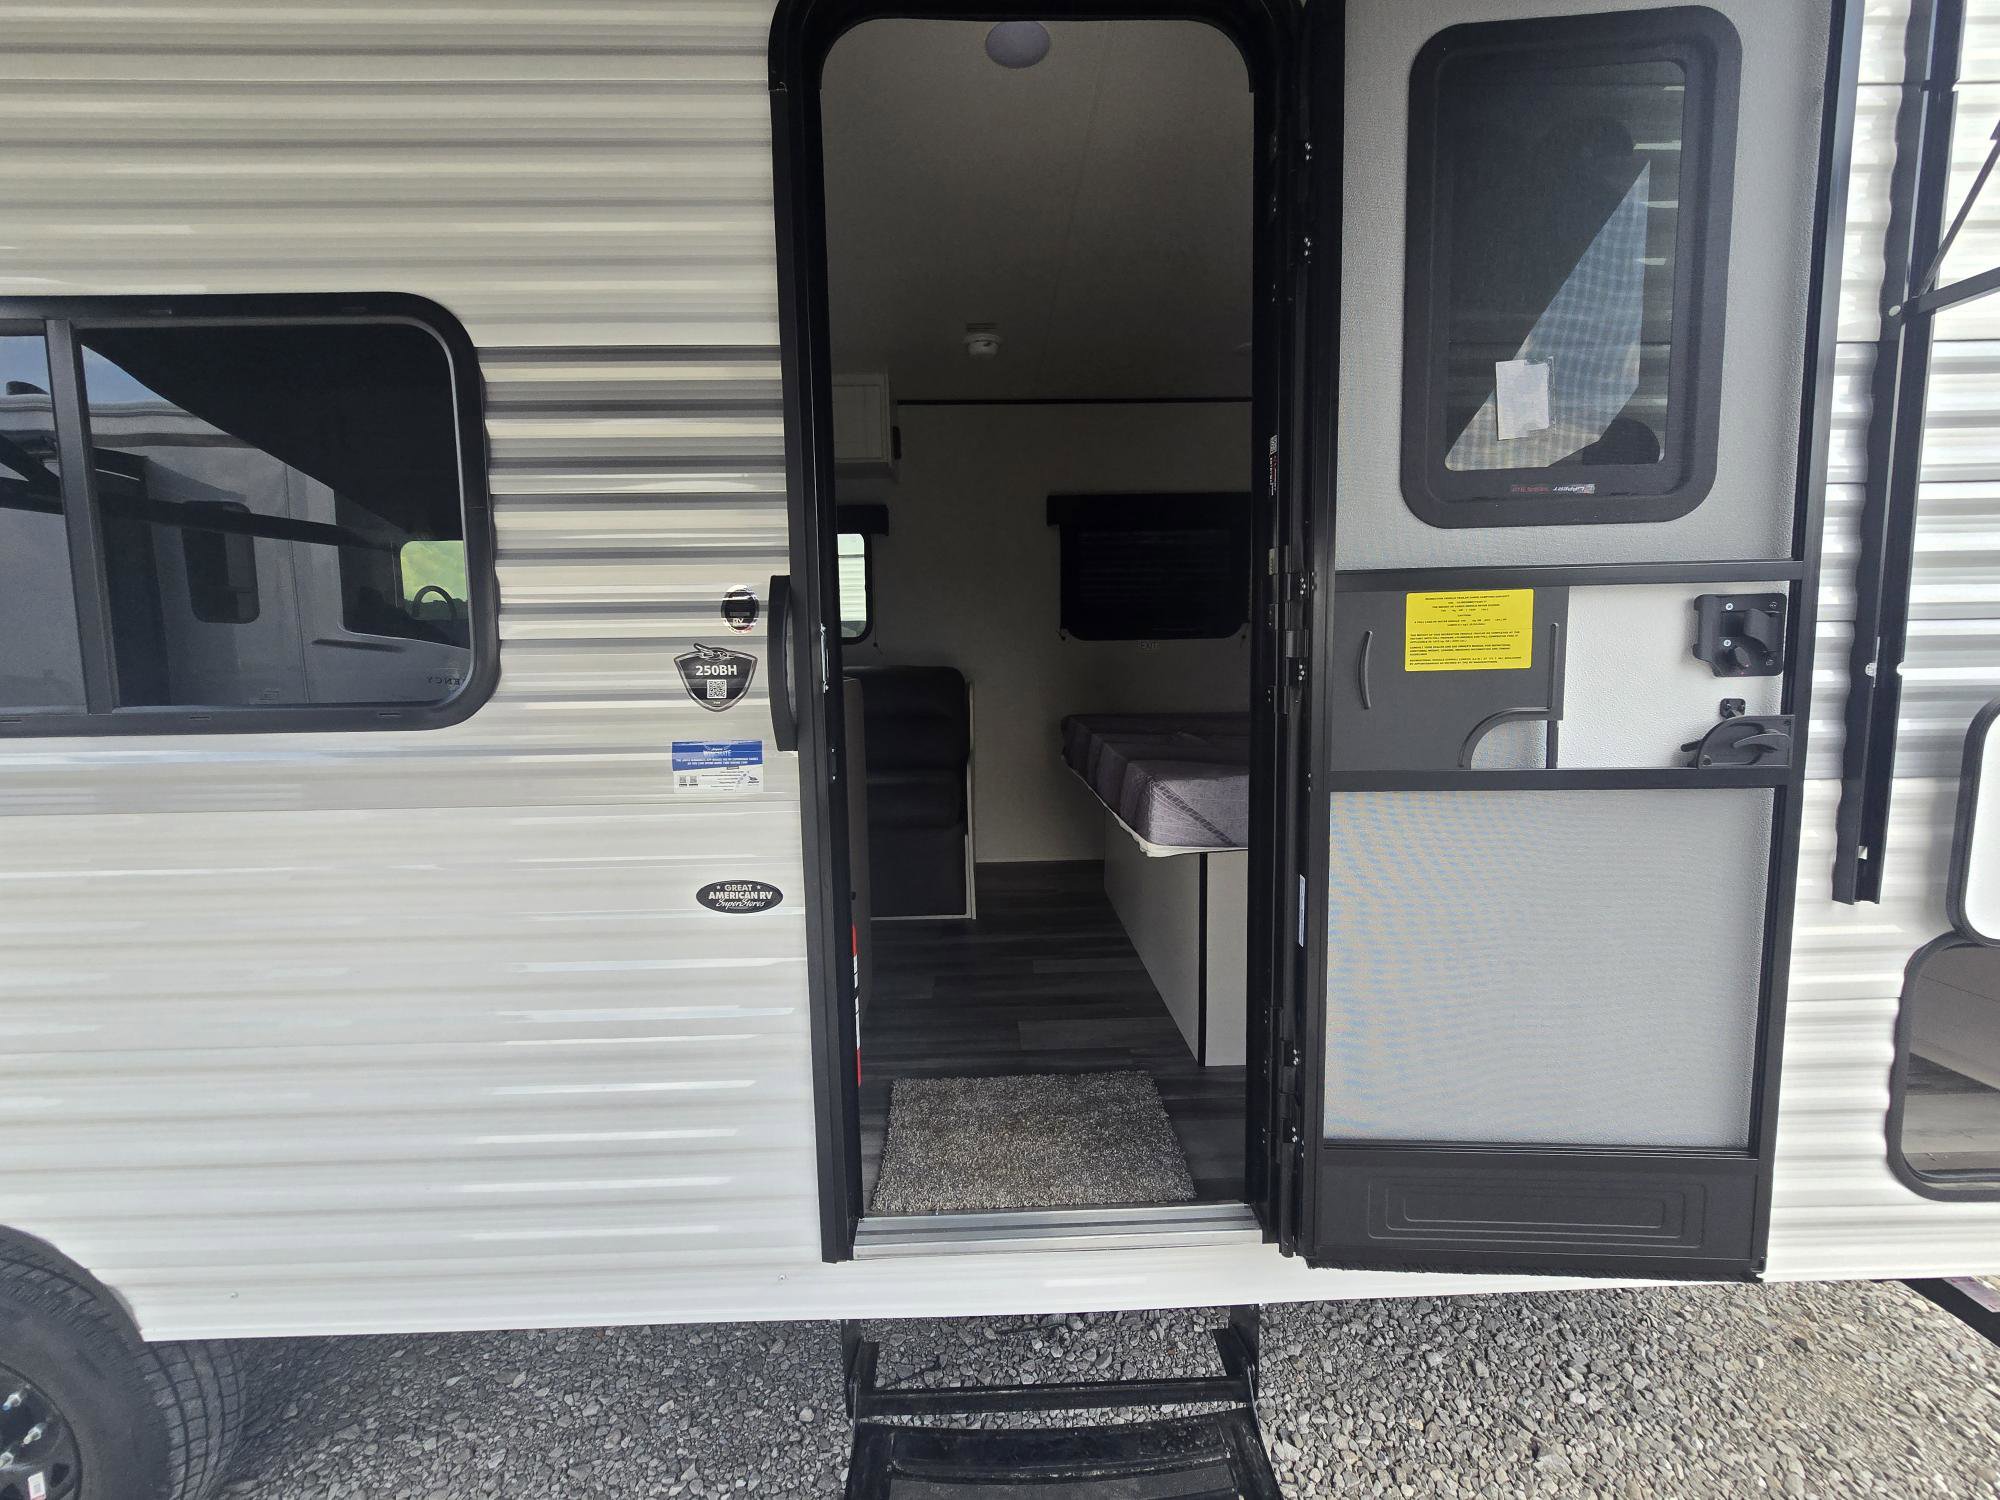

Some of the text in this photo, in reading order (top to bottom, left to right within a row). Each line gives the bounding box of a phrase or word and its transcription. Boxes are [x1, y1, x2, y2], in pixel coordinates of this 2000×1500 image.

[695, 665, 738, 676] 250BH
[724, 884, 753, 892] GREAT
[708, 891, 773, 900] AMERICAN RV
